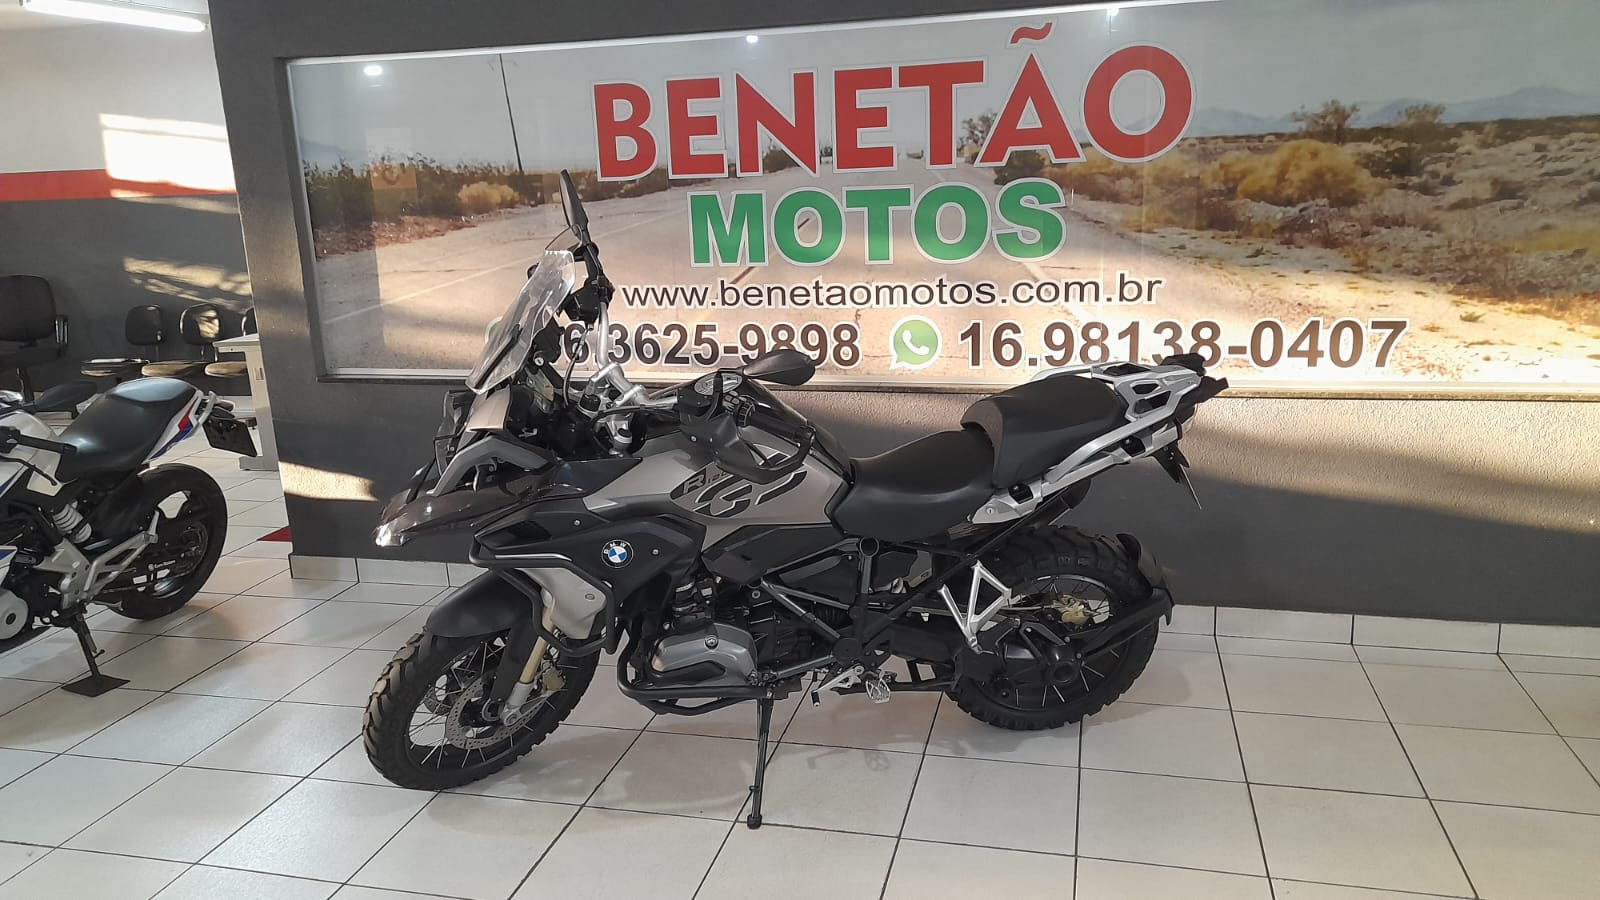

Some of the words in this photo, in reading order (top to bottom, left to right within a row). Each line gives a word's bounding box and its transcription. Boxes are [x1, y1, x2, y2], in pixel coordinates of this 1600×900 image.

[593, 22, 1193, 181] BENETÃO
[690, 181, 1065, 264] MOTOS
[622, 274, 1162, 306] www.benetaomotos.com.br
[563, 322, 860, 367] 63625-9898
[959, 319, 1408, 369] 16.98138-0407
